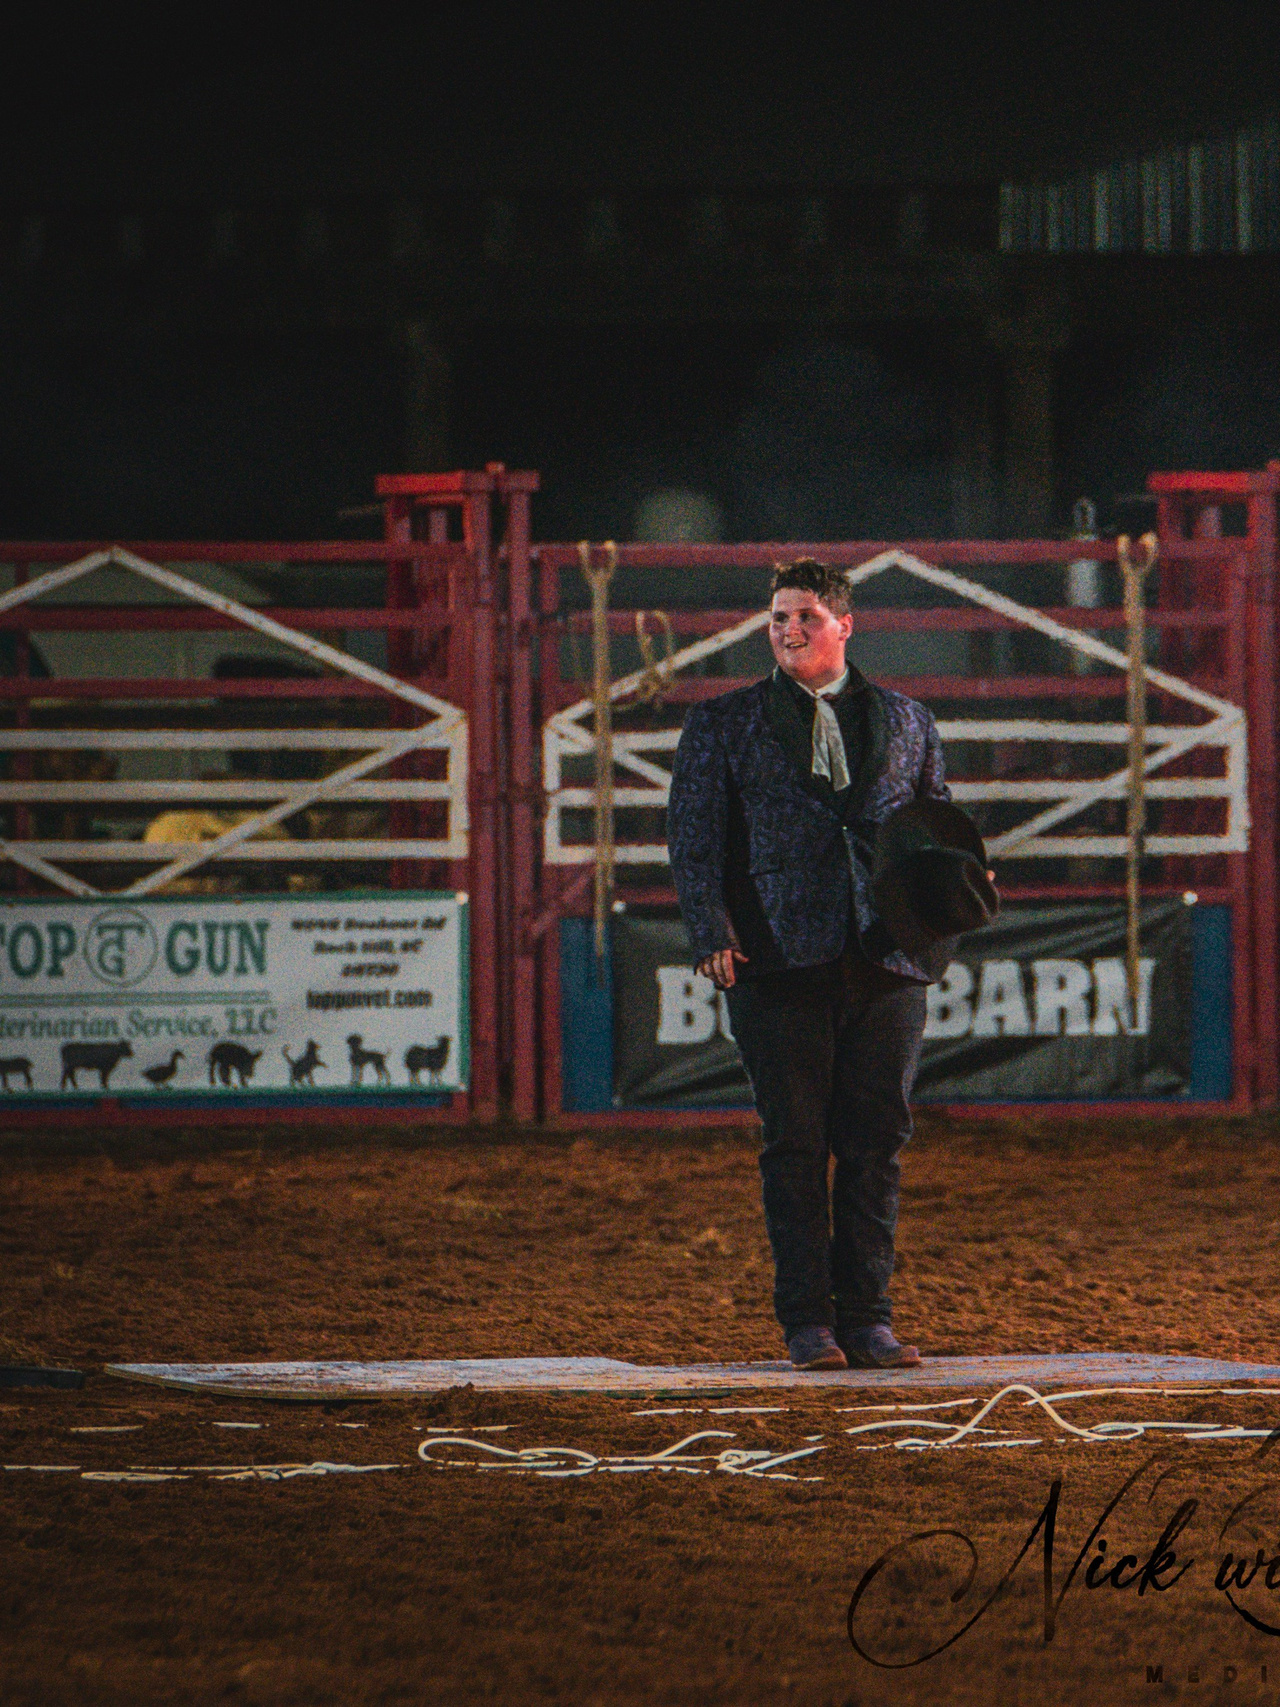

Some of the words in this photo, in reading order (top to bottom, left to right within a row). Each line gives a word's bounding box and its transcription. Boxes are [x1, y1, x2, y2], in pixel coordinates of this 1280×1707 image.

[165, 919, 270, 977] GUN
[127, 1007, 220, 1039] Service,
[225, 1007, 278, 1036] LLC
[922, 958, 1156, 1038] BARN
